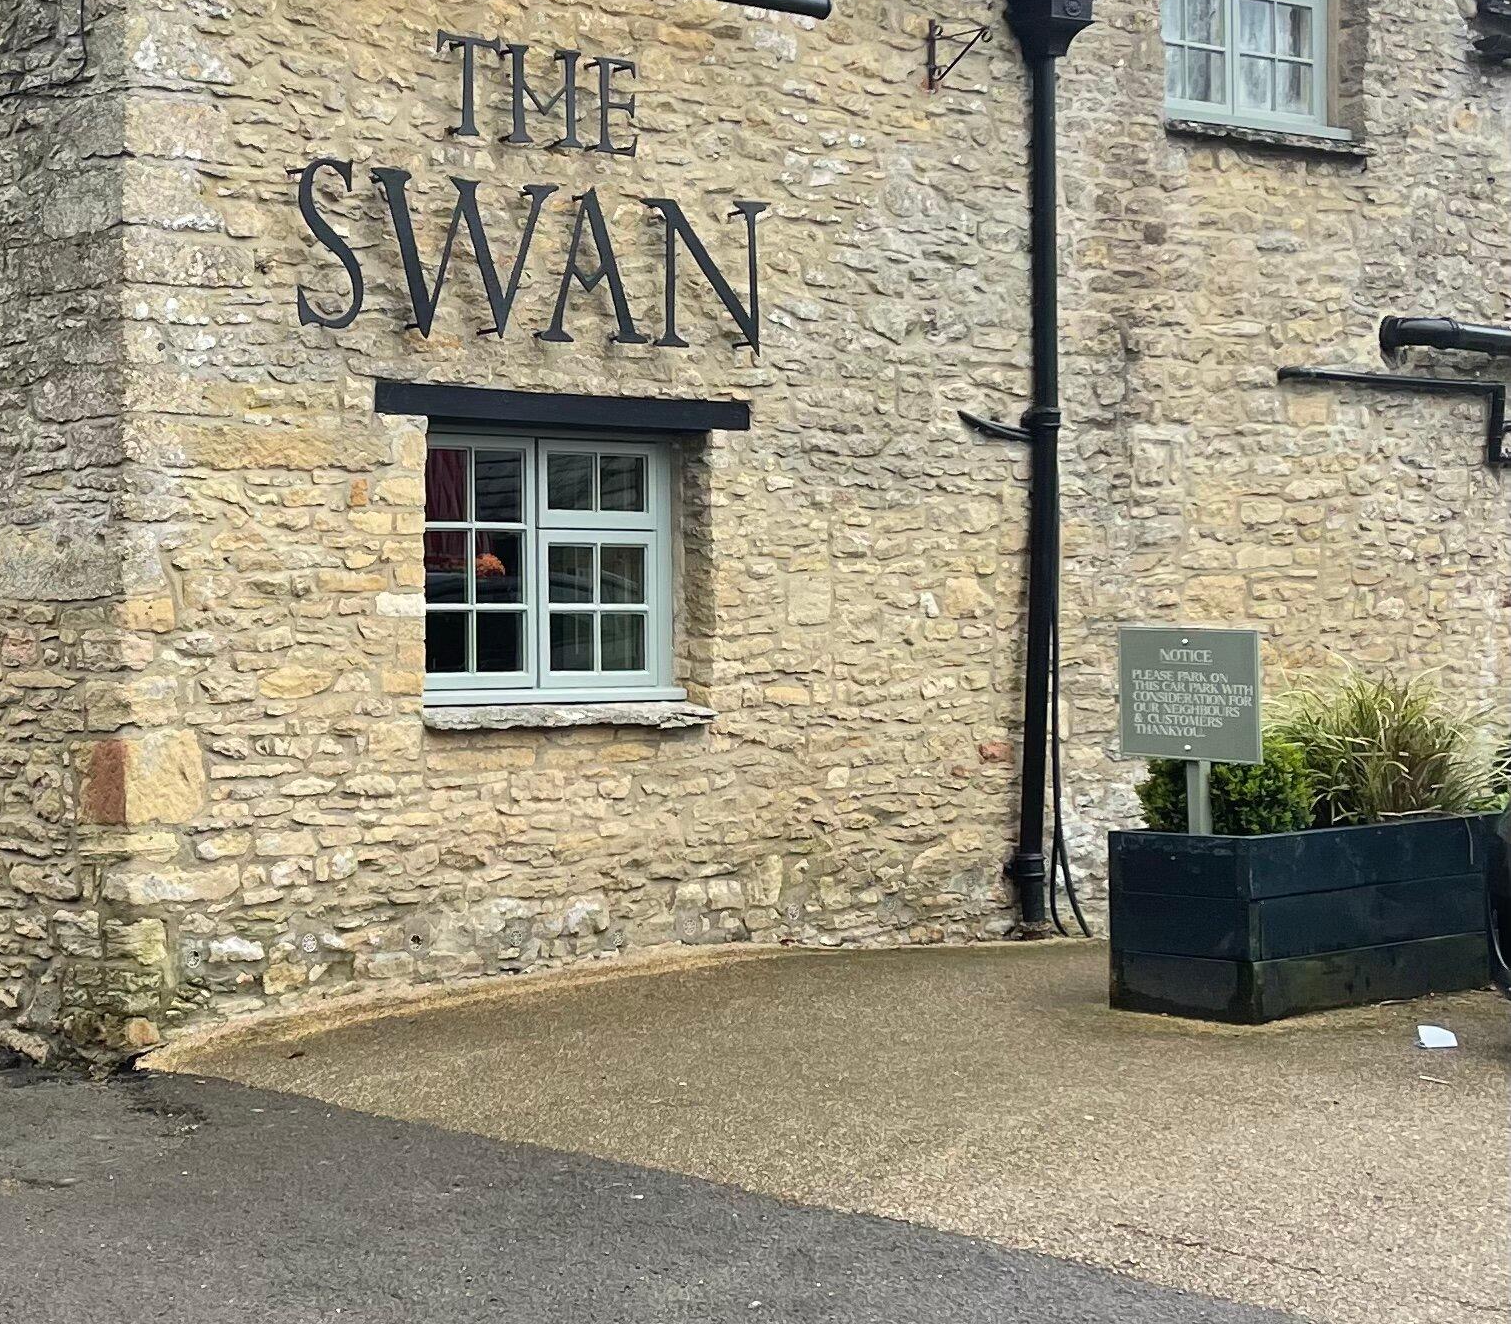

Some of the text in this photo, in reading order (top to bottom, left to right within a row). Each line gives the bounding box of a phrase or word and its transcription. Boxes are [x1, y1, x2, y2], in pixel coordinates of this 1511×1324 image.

[436, 29, 638, 157] THE
[296, 157, 772, 356] SWAN
[1159, 648, 1213, 663] NOTICE
[1132, 669, 1228, 683] PLEASE PARK ON
[1132, 679, 1254, 696] THIS CAR PARK WITH
[1133, 691, 1253, 707] CONSIDERATION FOR
[1133, 702, 1240, 718] OUR NEIGHBOURS
[1133, 712, 1223, 728] & CUSTOMERS
